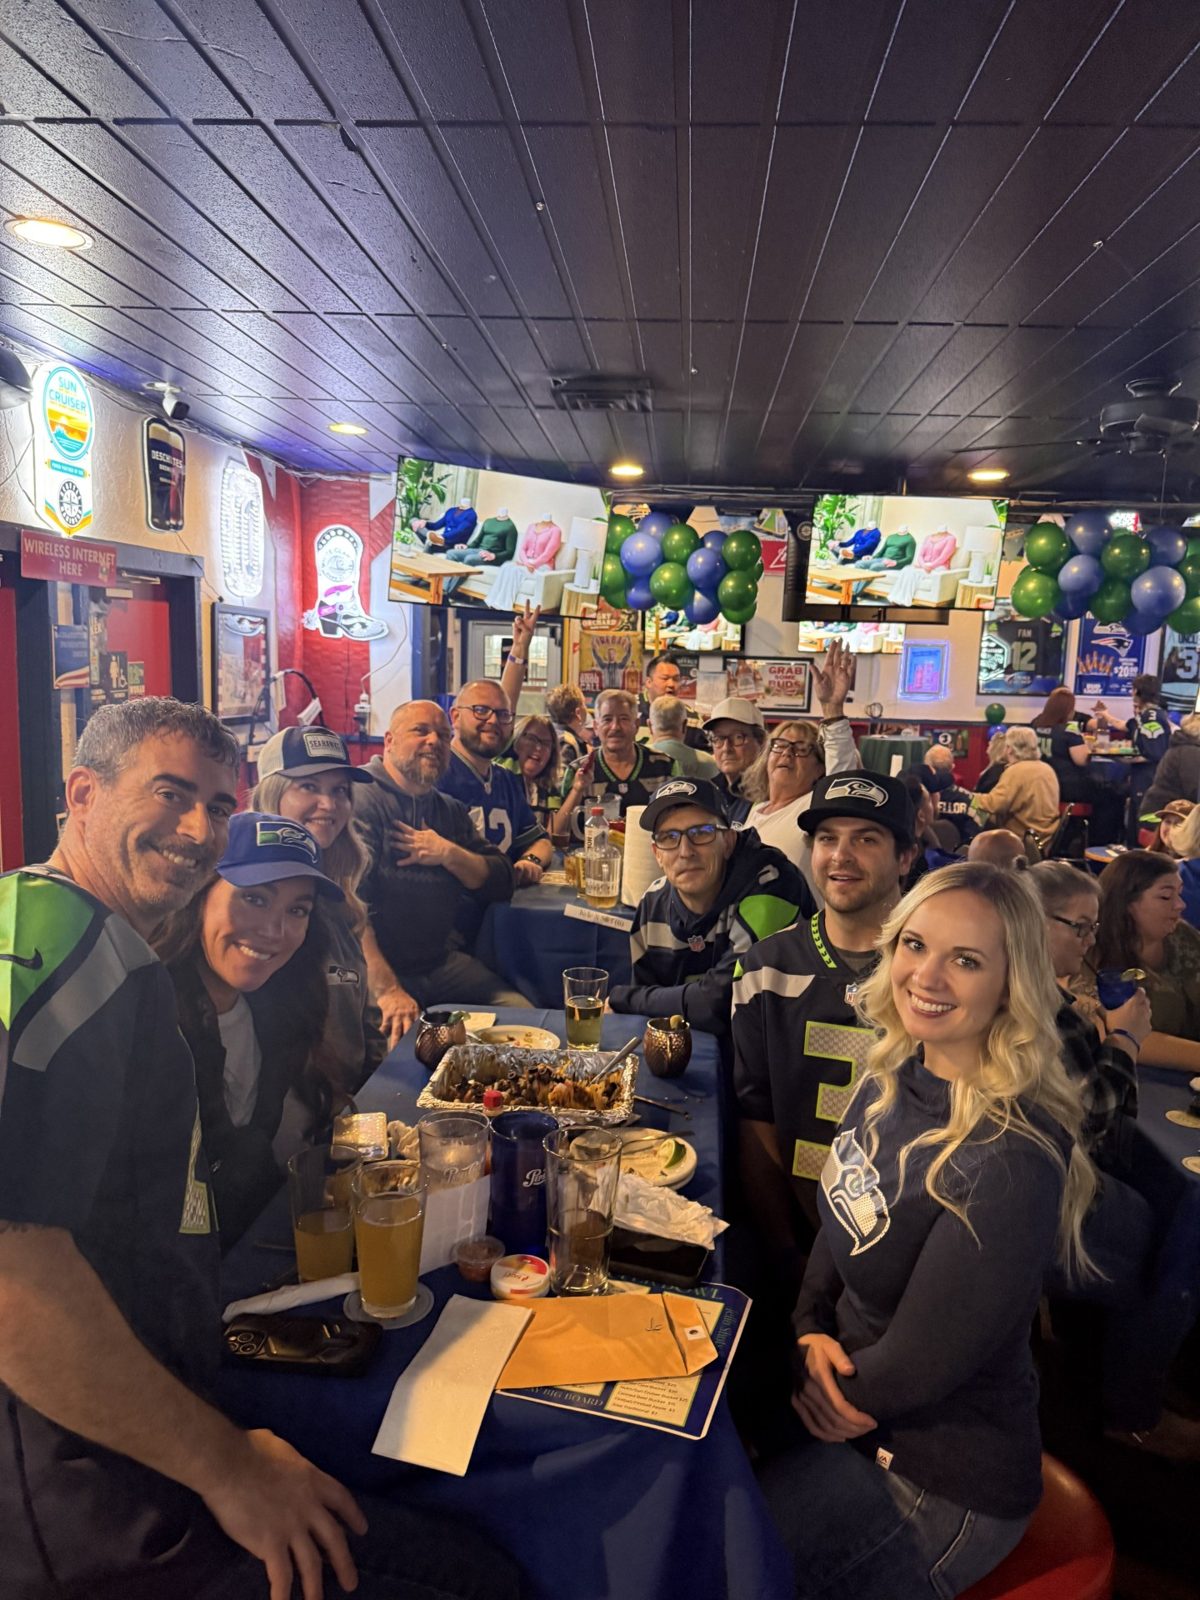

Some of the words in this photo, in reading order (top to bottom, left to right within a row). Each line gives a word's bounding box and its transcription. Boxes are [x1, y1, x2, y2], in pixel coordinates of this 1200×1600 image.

[58, 376, 77, 392] SUN
[49, 388, 86, 412] CRUISER
[24, 537, 71, 560] WIRELESS
[72, 548, 116, 567] INTERNET
[59, 562, 83, 577] HERE
[1011, 641, 1037, 671] 12
[1176, 649, 1199, 679] 3
[768, 666, 803, 675] GRAB
[768, 680, 802, 689] BUDS
[1148, 710, 1157, 721] 3
[543, 1386, 562, 1400] BIG
[564, 1391, 604, 1407] BOARD
